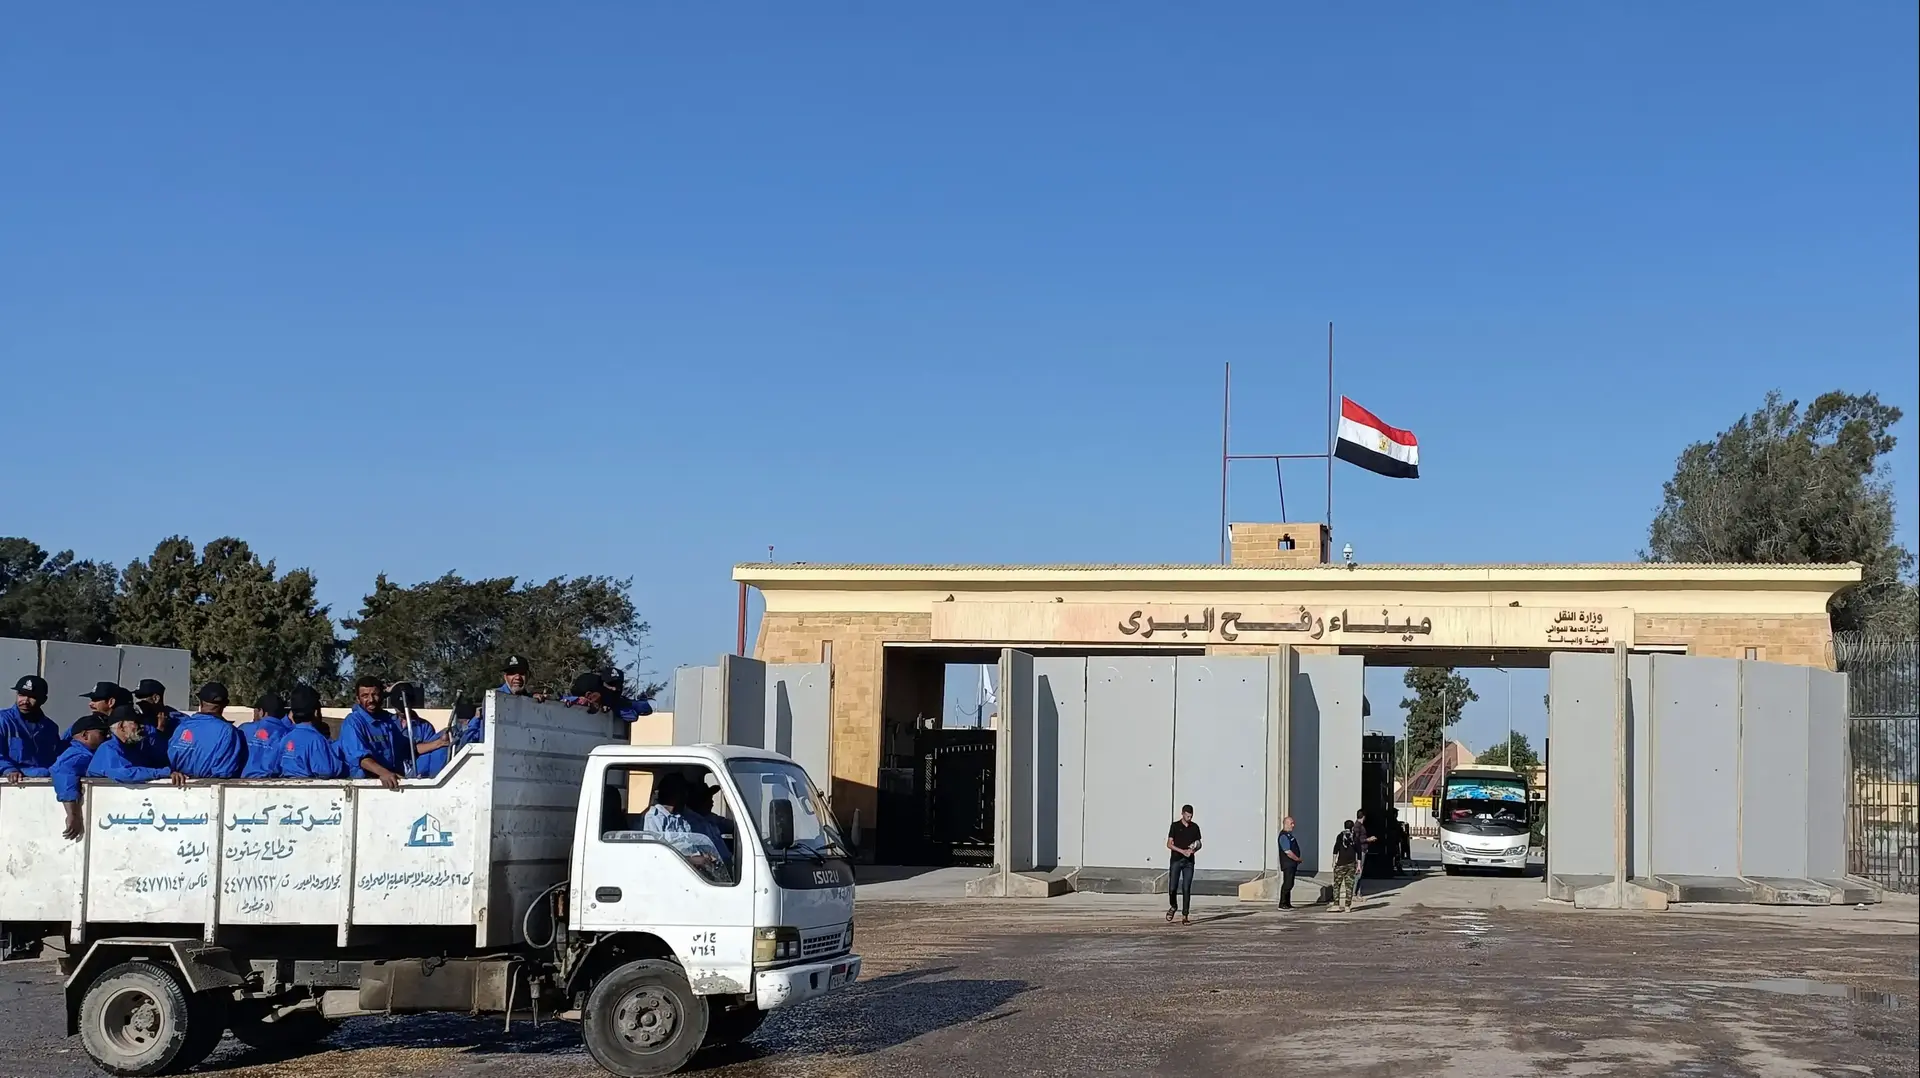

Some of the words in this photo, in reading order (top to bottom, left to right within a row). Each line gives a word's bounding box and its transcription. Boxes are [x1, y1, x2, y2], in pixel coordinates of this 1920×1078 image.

[1221, 605, 1325, 641] رفح
[1554, 610, 1577, 623] النقل
[1579, 611, 1603, 624] وزارة
[1328, 608, 1432, 642] ميناء
[225, 805, 277, 833] كير
[279, 801, 342, 831] شركة
[177, 840, 209, 864] البيئة
[226, 841, 261, 861] شئون
[261, 839, 297, 860] قطاع
[292, 874, 315, 890] العبور
[310, 877, 329, 890] سوق
[324, 874, 342, 890] بجوار
[416, 874, 434, 886] مصر
[428, 870, 450, 887] طريق
[812, 869, 841, 885] ISUZU
[690, 945, 716, 956] ٧٦٤٩
